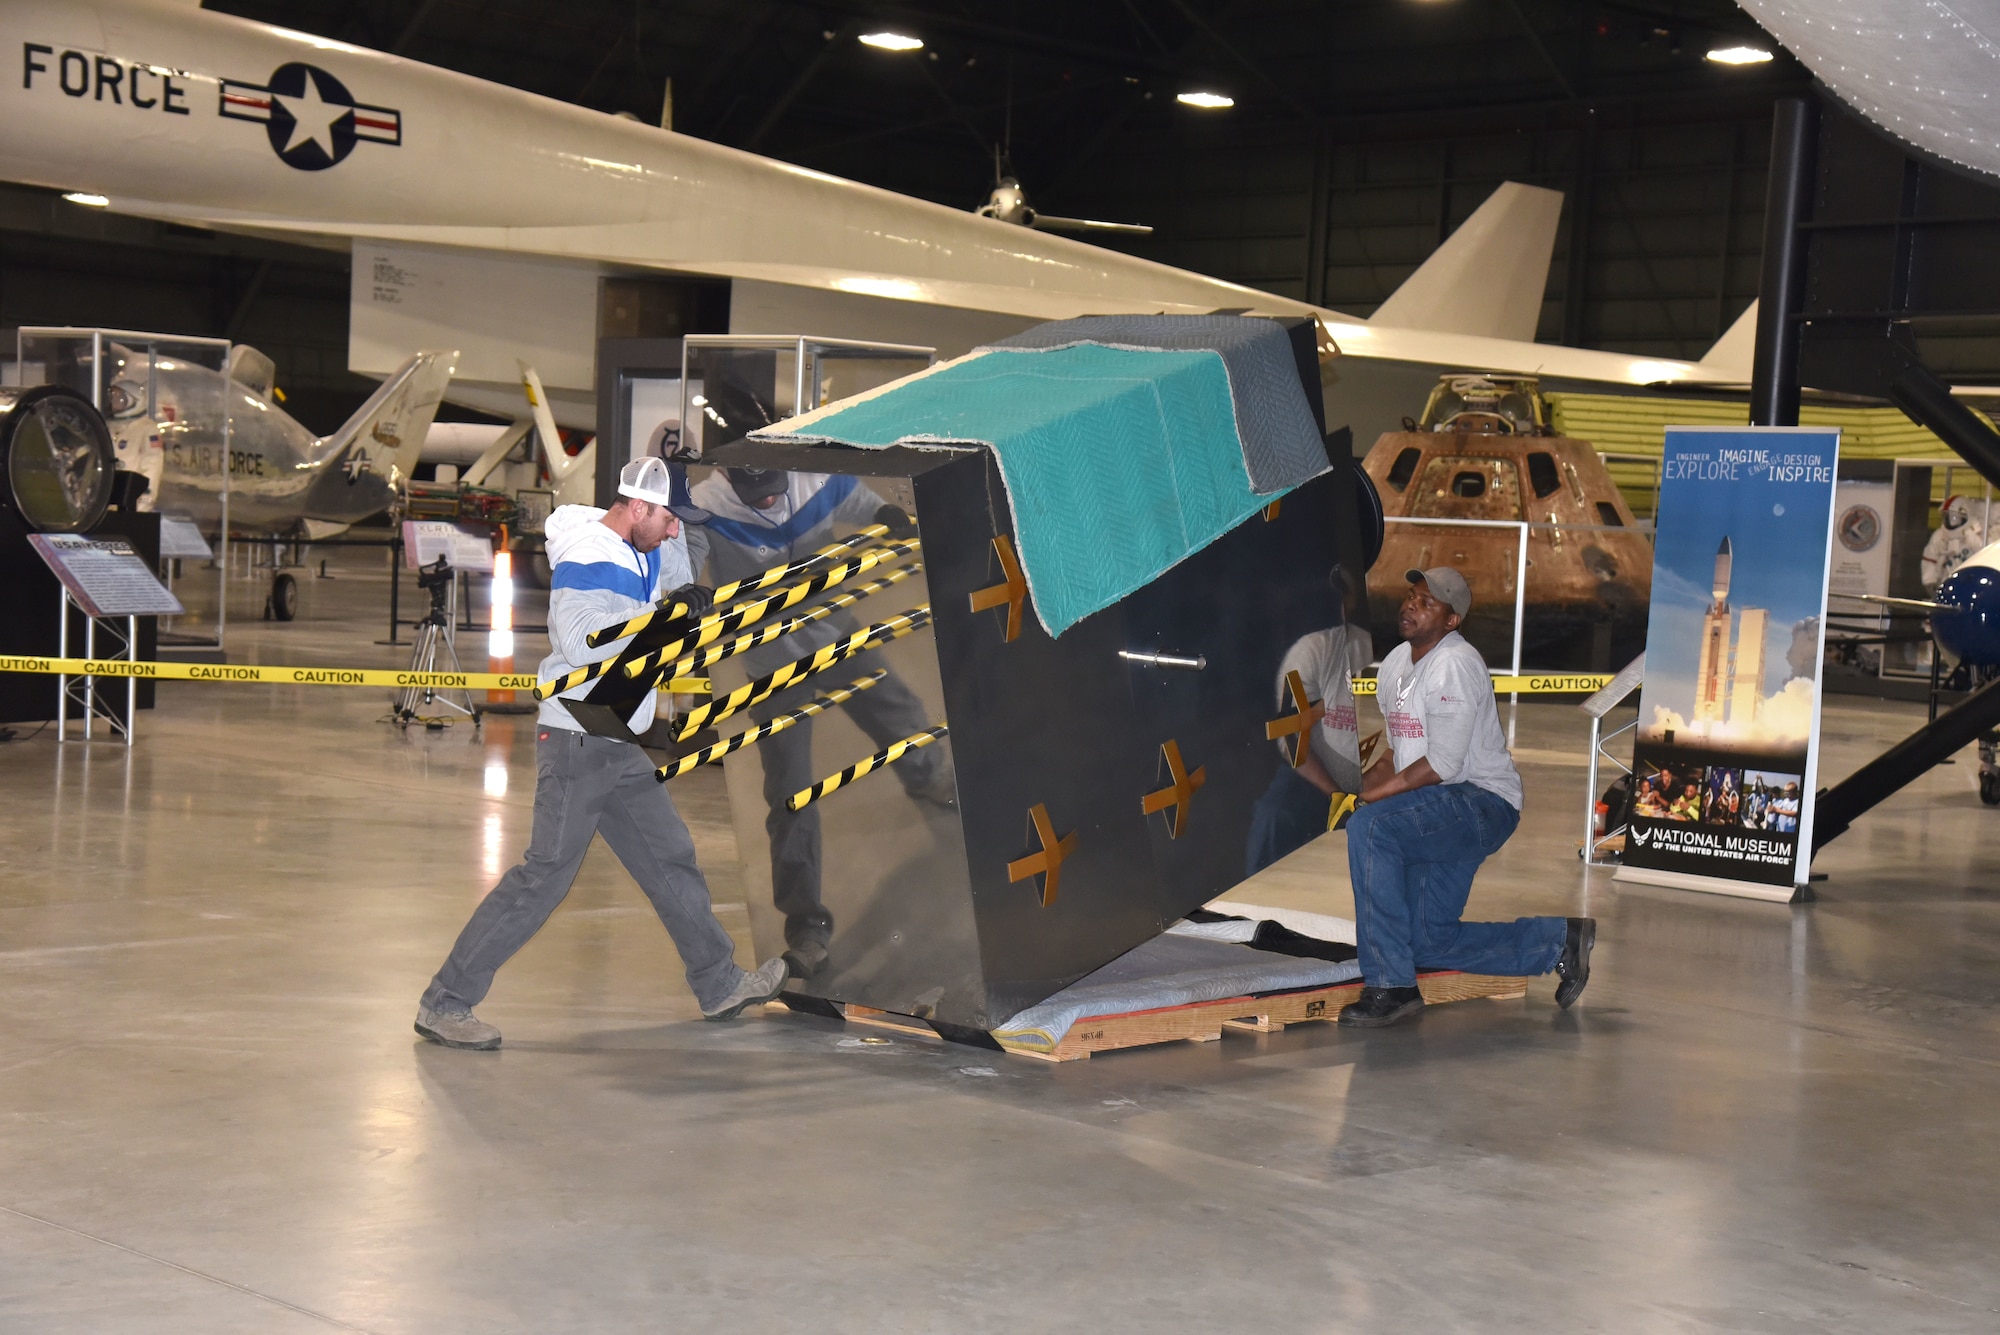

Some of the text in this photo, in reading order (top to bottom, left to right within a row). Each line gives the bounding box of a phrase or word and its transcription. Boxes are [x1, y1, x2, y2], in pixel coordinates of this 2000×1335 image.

[23, 42, 190, 115] FORCE
[1676, 449, 1821, 466] ENGINEER IMAGINE DESIGN
[1748, 453, 1783, 477] ENGAGE
[1665, 460, 1831, 483] EXPLORE INSPIRE
[0, 658, 537, 688] UTION CAUTION CAUTION CAUTION CAUTION CAUT
[1530, 678, 1603, 690] CAUTION
[1652, 841, 1790, 865] OF THE UNITED STATES AIR FORCE
[1653, 828, 1791, 856] NATIONAL MUSEUM
